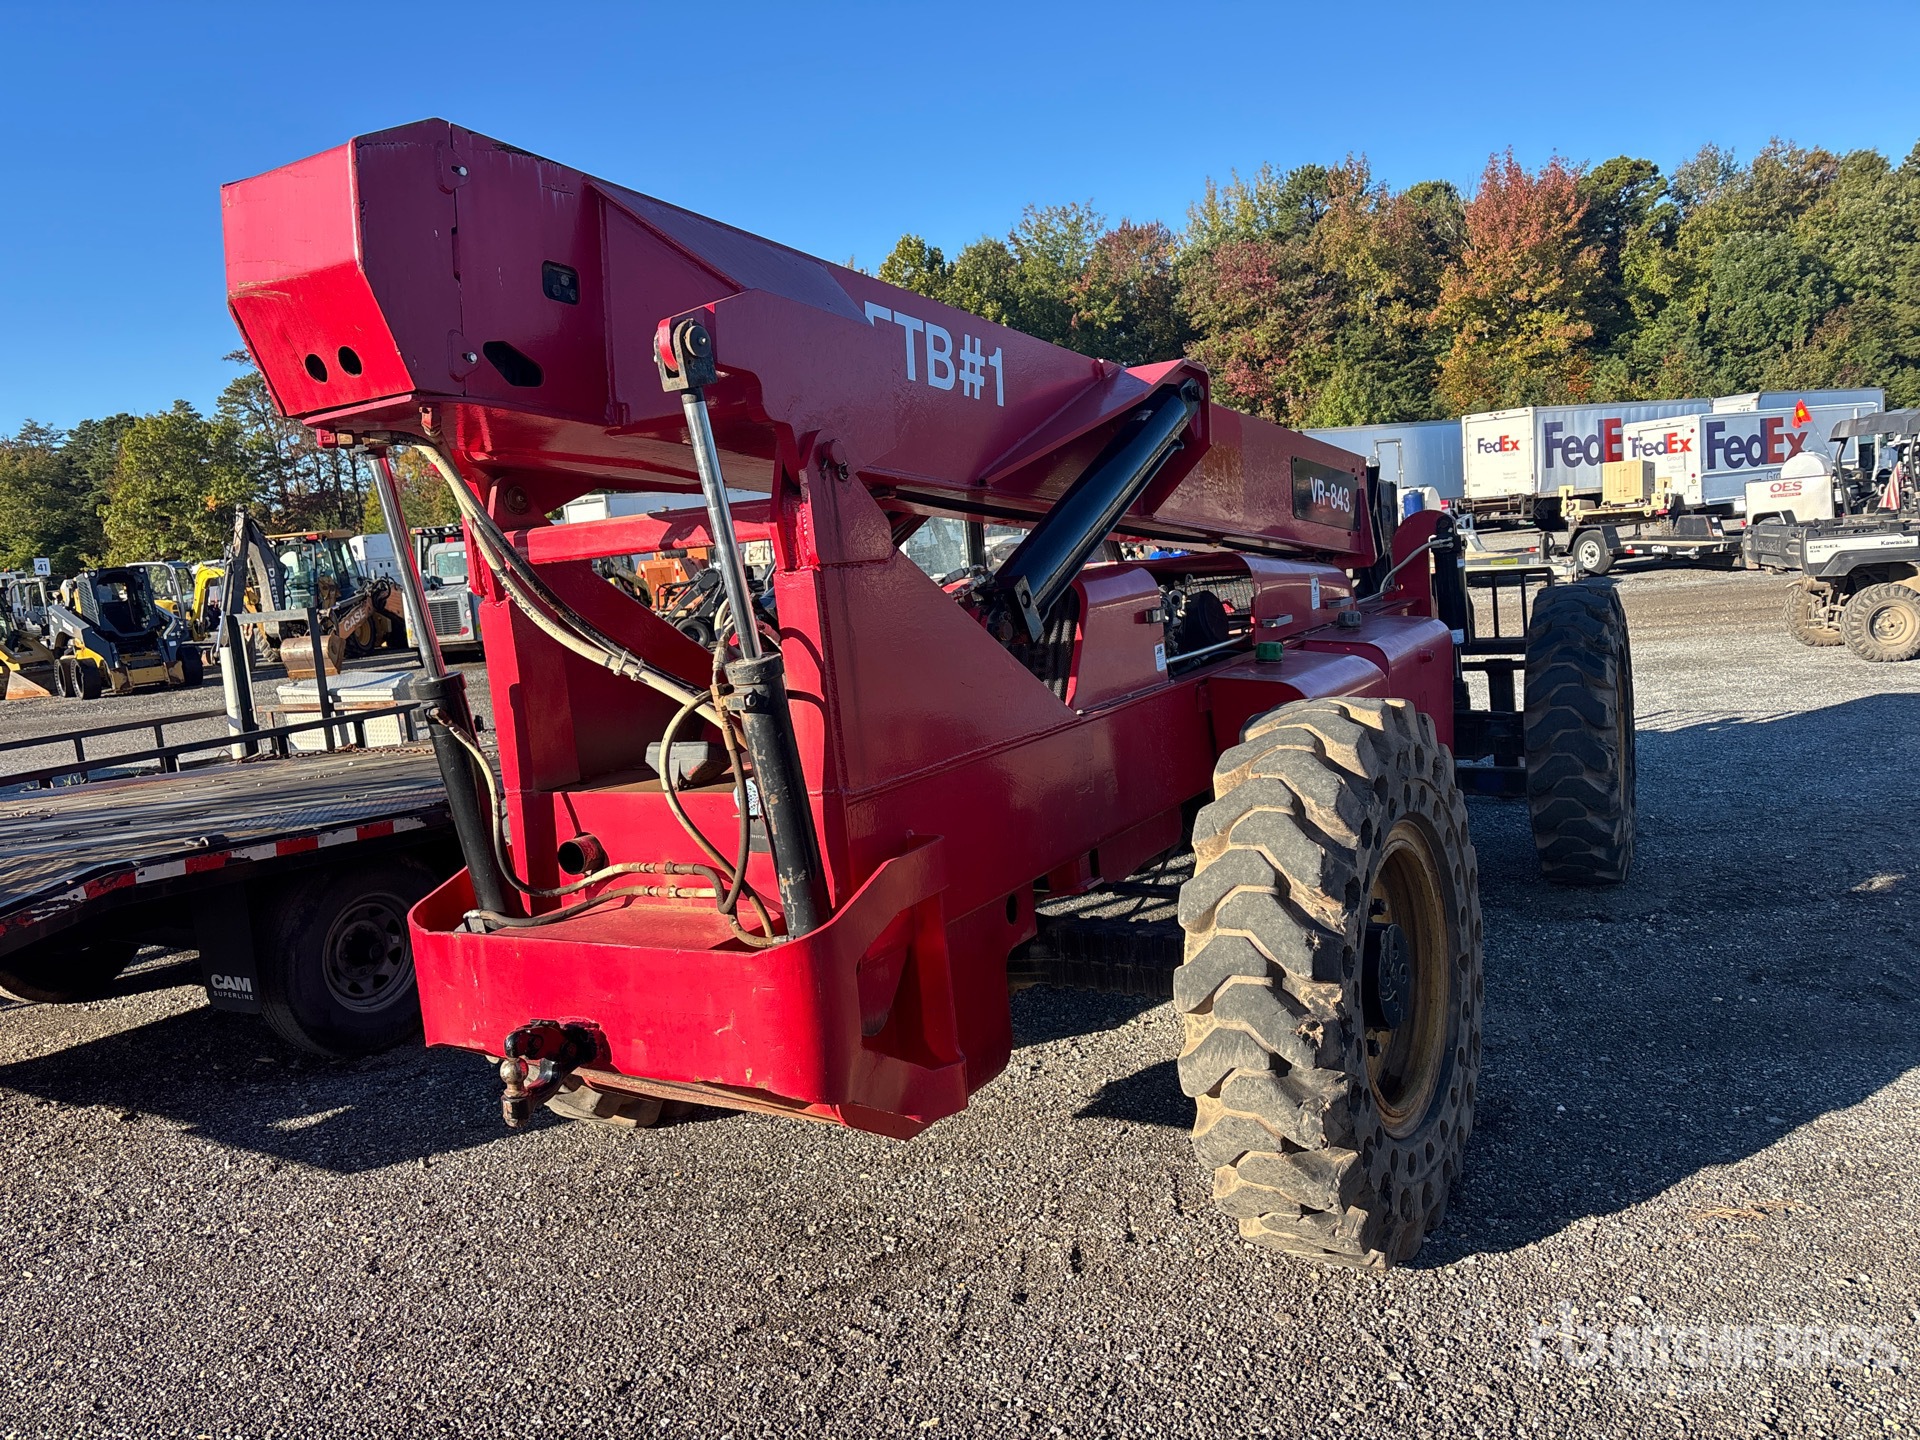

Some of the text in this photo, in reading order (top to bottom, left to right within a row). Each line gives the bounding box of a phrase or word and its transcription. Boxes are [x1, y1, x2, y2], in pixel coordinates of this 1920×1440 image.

[1477, 434, 1520, 454] FedEx
[1543, 417, 1622, 469] FedE
[1630, 432, 1693, 458] FedEx
[1706, 416, 1808, 470] FedEx
[1309, 476, 1350, 513] VR-843
[1769, 481, 1803, 493] OES
[1880, 538, 1913, 546] Kawasaki
[37, 563, 48, 572] 41
[343, 609, 366, 632] CASE
[211, 974, 252, 992] CAM
[213, 991, 254, 1001] SUPERLINE
